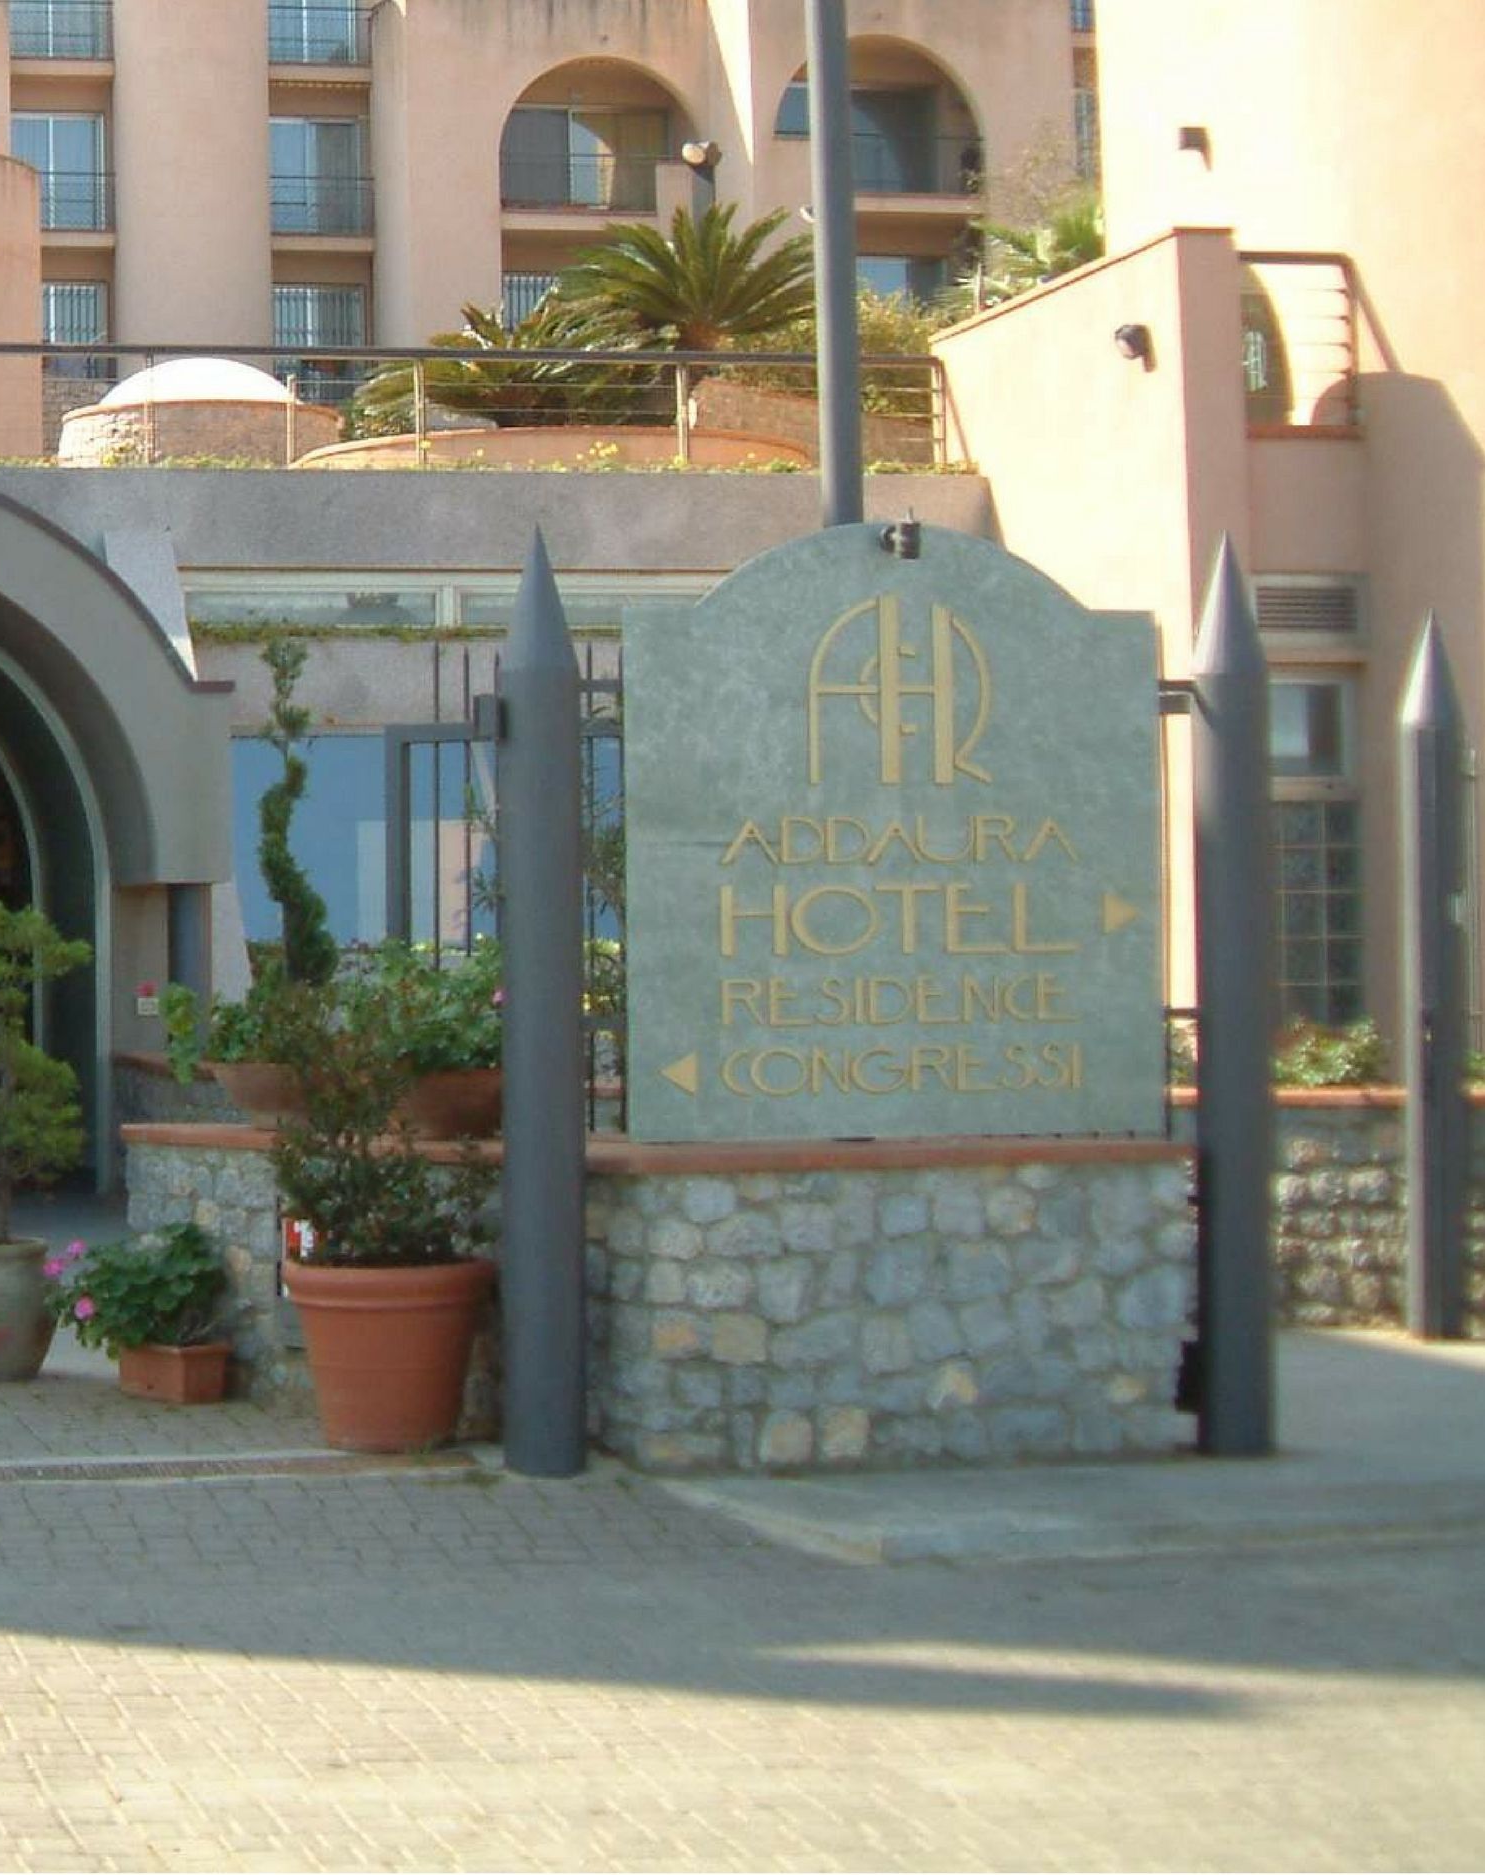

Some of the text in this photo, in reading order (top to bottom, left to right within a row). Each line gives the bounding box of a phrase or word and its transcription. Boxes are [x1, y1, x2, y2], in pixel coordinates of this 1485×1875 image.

[721, 816, 1079, 865] ADDAURA
[721, 883, 1082, 957] HOTEL
[721, 973, 1082, 1026] RESIDENCE
[722, 1043, 1083, 1096] CONGRESSI
